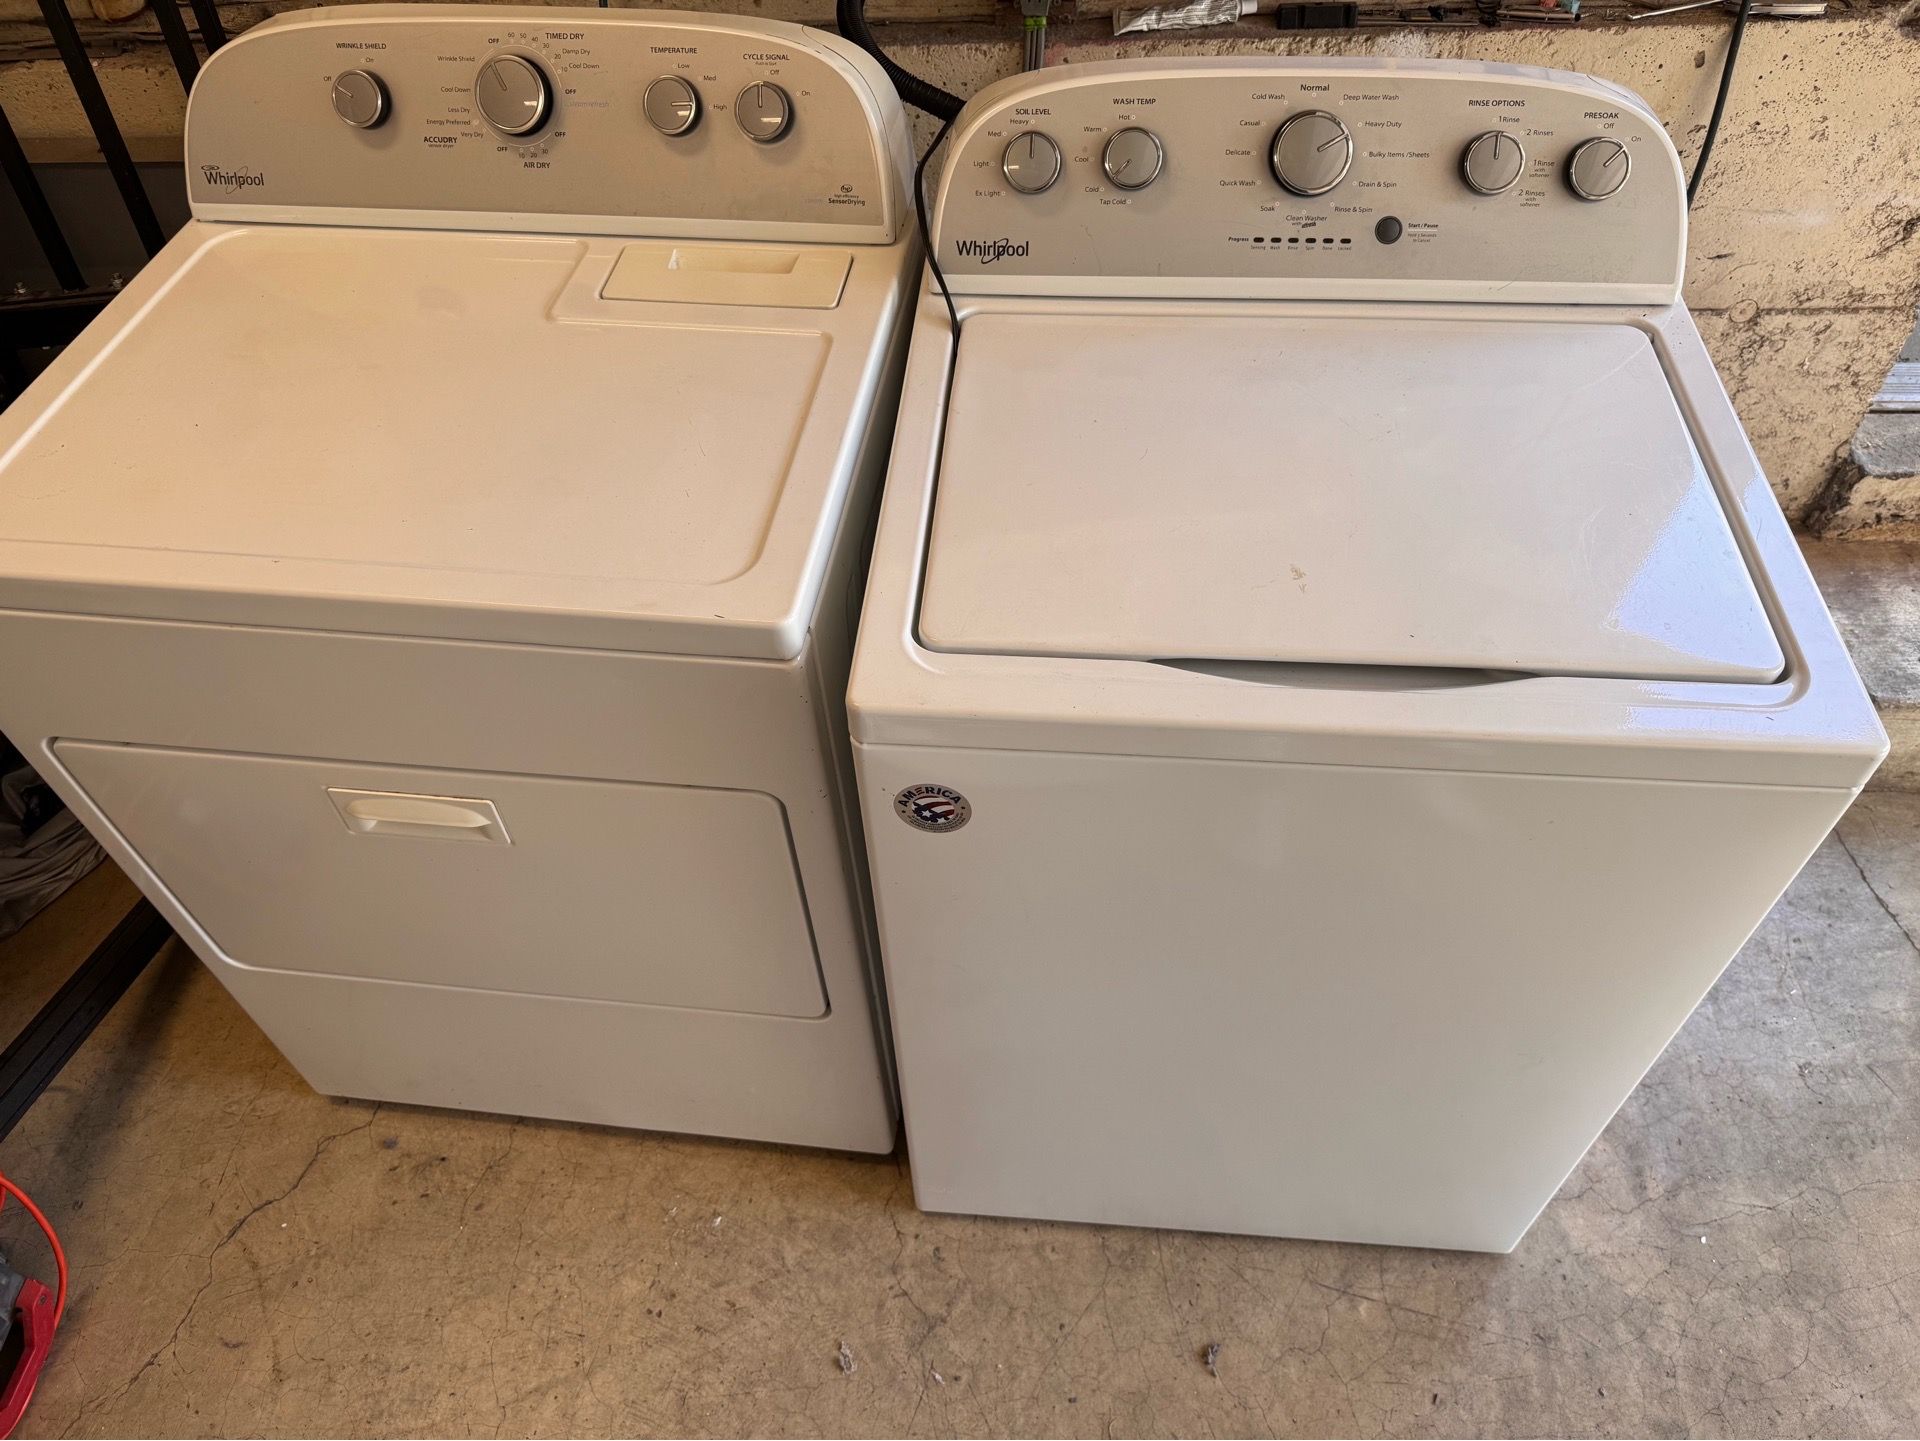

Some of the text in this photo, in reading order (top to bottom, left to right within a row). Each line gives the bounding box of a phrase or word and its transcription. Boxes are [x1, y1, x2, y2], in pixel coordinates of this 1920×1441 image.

[545, 32, 568, 40] TIMED
[335, 42, 387, 50] WRINKLE SHIELD
[562, 48, 591, 56] Damp Dry
[650, 46, 698, 55] TEMPERATURE
[742, 53, 791, 61] CYCLE SIGNAL
[1300, 84, 1330, 92] Normal
[1268, 93, 1286, 101] Wash
[1343, 94, 1361, 102] Deep
[713, 103, 728, 111] High
[1468, 99, 1526, 108] RINSE OPTIONS
[460, 107, 471, 115] Dry
[1015, 108, 1052, 116] SOIL LEVEL
[1503, 116, 1521, 124] Rinse
[1583, 112, 1620, 120] PRESOAK
[426, 118, 471, 126] Energy Preferred
[1009, 118, 1030, 126] Heavy
[1239, 119, 1261, 127] Casual
[1364, 121, 1402, 129] Heavy Duty
[1603, 122, 1615, 130] Off
[1083, 125, 1102, 133] Warm
[1526, 128, 1554, 137] 2 Rinses
[460, 131, 484, 139] Very Dry
[423, 136, 458, 144] ACCUDRY
[1368, 151, 1386, 159] Bulky
[973, 160, 990, 168] Light
[1074, 156, 1089, 164] Cool
[523, 161, 551, 169] AIR DRY
[203, 171, 265, 190] Whirlpool
[1084, 186, 1099, 194] Cold
[1518, 189, 1524, 197] 2
[975, 190, 1001, 199] Ex Light
[828, 197, 866, 207] SensorDrying
[1100, 198, 1127, 207] Tap Cold
[1358, 206, 1373, 214] Spin
[1285, 214, 1304, 222] Clean
[956, 239, 1029, 262] Whirlpool
[898, 786, 962, 808] AMERICA
